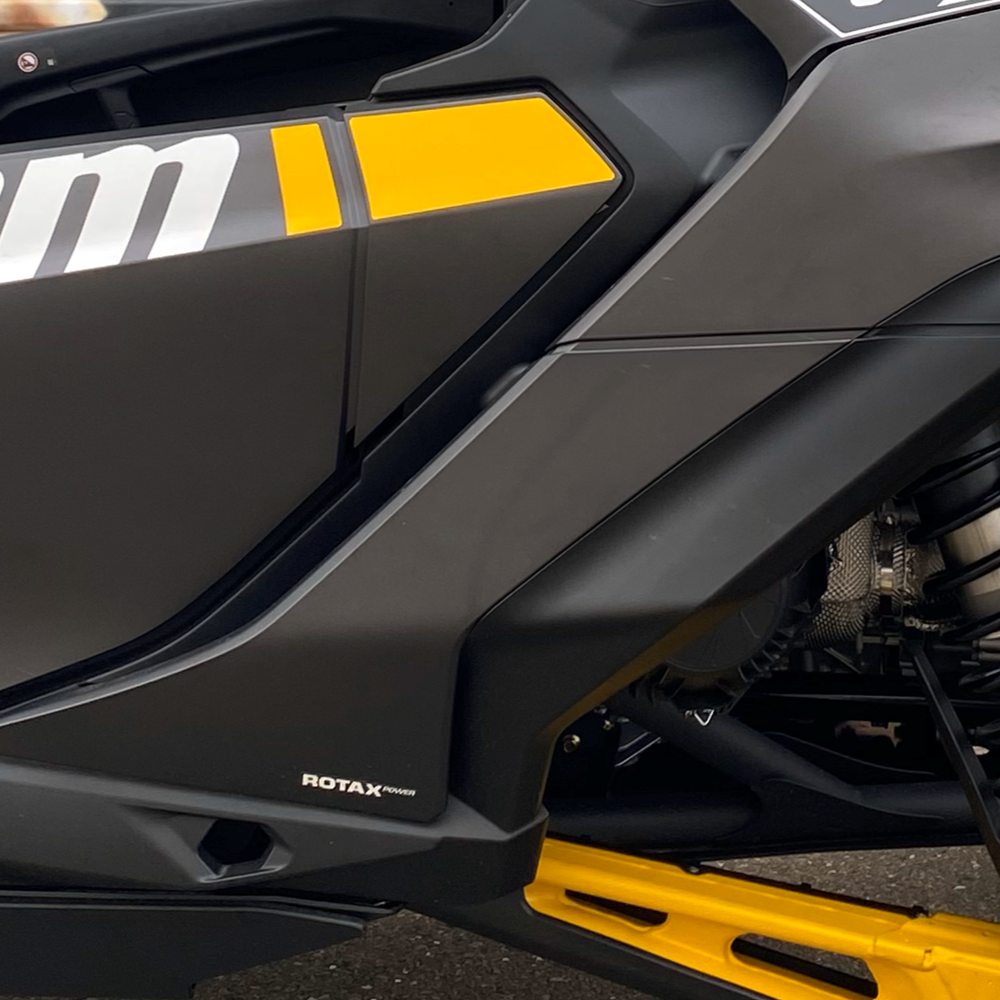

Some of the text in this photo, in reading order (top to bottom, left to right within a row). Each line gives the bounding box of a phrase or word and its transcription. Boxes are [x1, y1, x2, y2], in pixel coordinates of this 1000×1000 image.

[0, 133, 240, 284] m
[302, 773, 416, 797] ROTAX POWER
